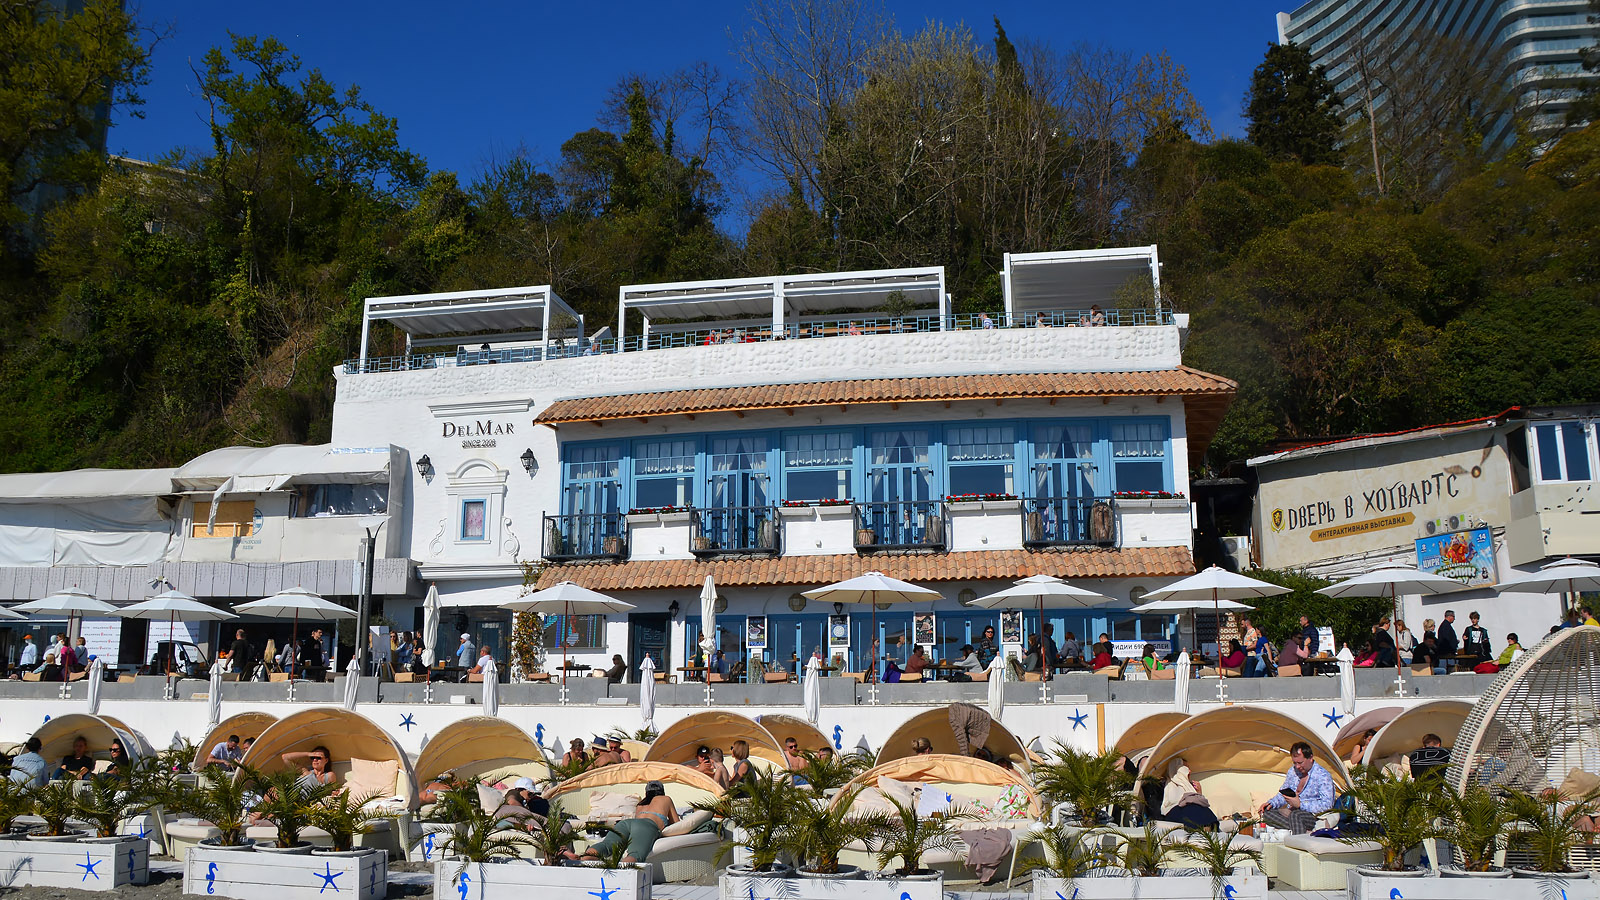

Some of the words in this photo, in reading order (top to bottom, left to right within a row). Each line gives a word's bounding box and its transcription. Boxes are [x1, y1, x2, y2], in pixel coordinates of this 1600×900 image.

[461, 440, 481, 449] SINCE
[1288, 500, 1336, 530] ДВЕРЬ
[1344, 494, 1354, 519] В
[1362, 472, 1459, 516] ХОГВАРТС
[1317, 523, 1369, 539] ИНТЕРАКТИВНАЯ
[1370, 516, 1406, 531] ВЫСТАВКА
